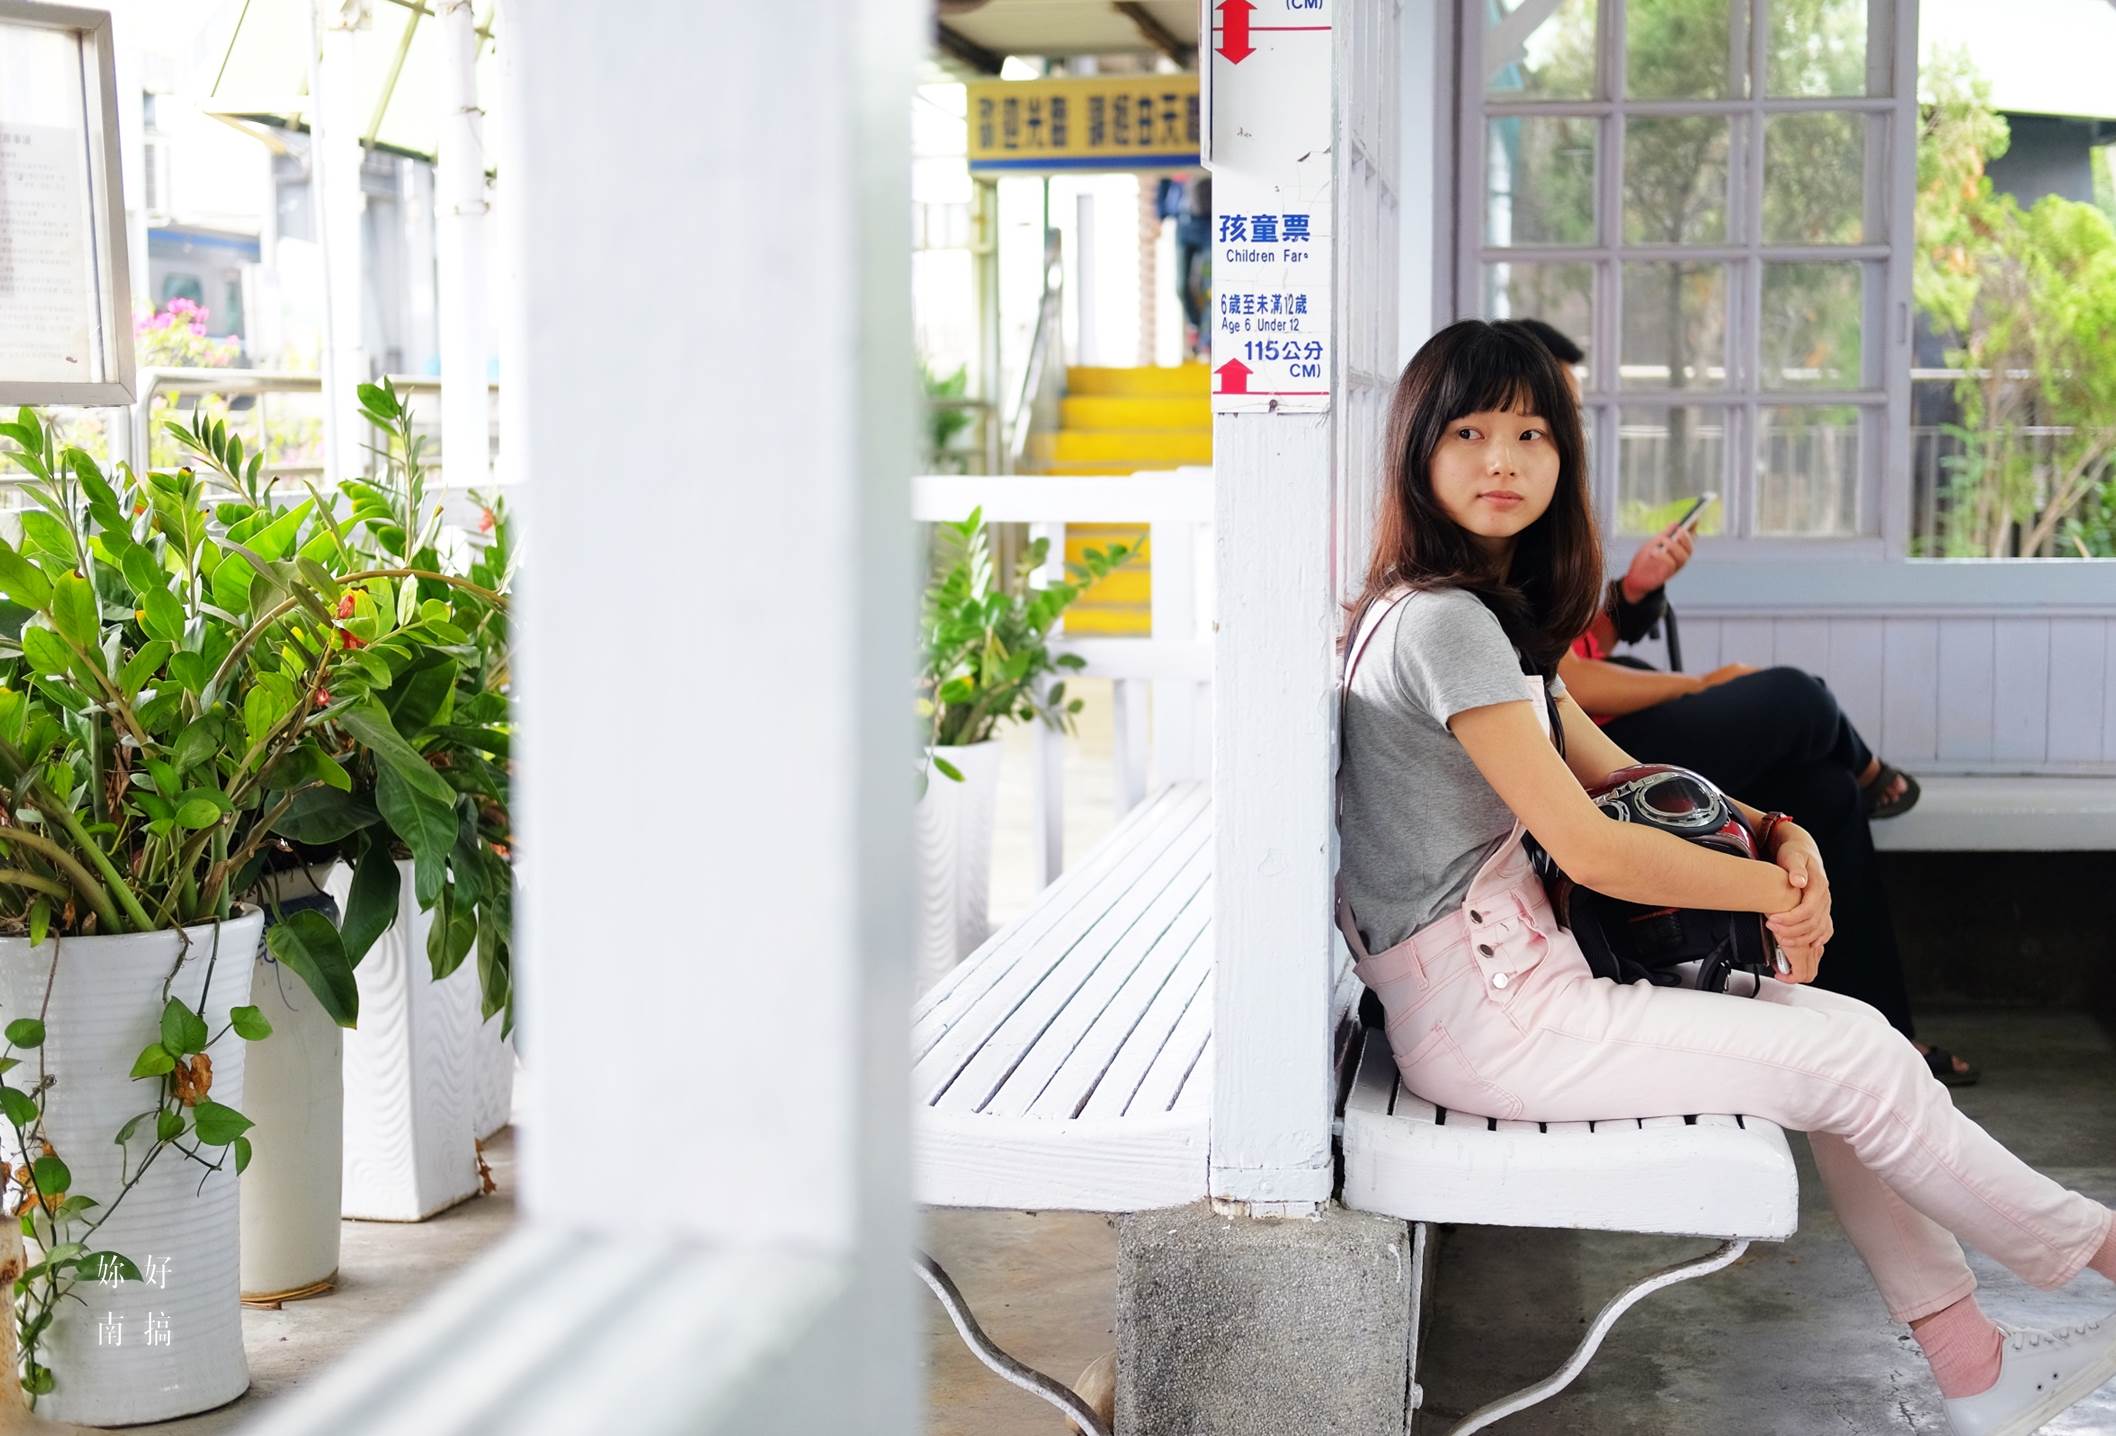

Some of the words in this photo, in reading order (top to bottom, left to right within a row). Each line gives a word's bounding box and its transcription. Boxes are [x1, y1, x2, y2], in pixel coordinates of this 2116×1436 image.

[1286, 0, 1323, 10] (CM)
[1219, 214, 1310, 242] 孩童票
[1226, 249, 1275, 262] Children
[1221, 317, 1240, 334] Age
[1244, 318, 1251, 331] 6
[1257, 318, 1286, 331] Under
[1289, 318, 1299, 331] 12
[1244, 340, 1323, 361] 115公分
